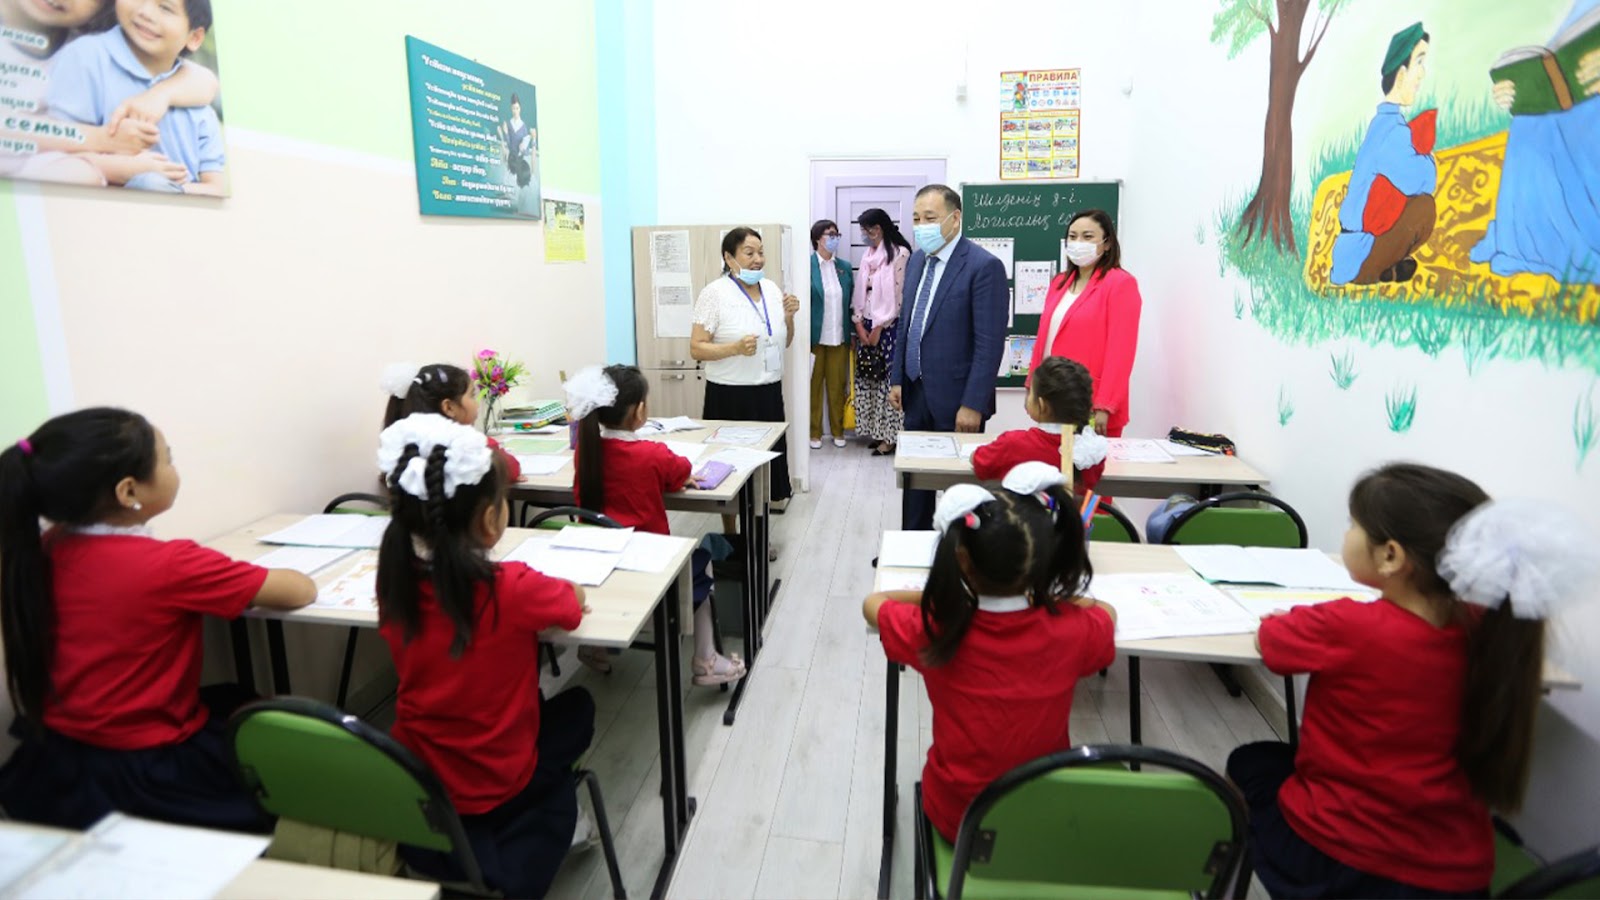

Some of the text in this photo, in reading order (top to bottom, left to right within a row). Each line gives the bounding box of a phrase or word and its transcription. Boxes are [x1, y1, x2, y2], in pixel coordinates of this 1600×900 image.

[1029, 72, 1078, 83] ПРАВИЛА
[5, 117, 84, 141] семьи,
[0, 139, 35, 153] ира
